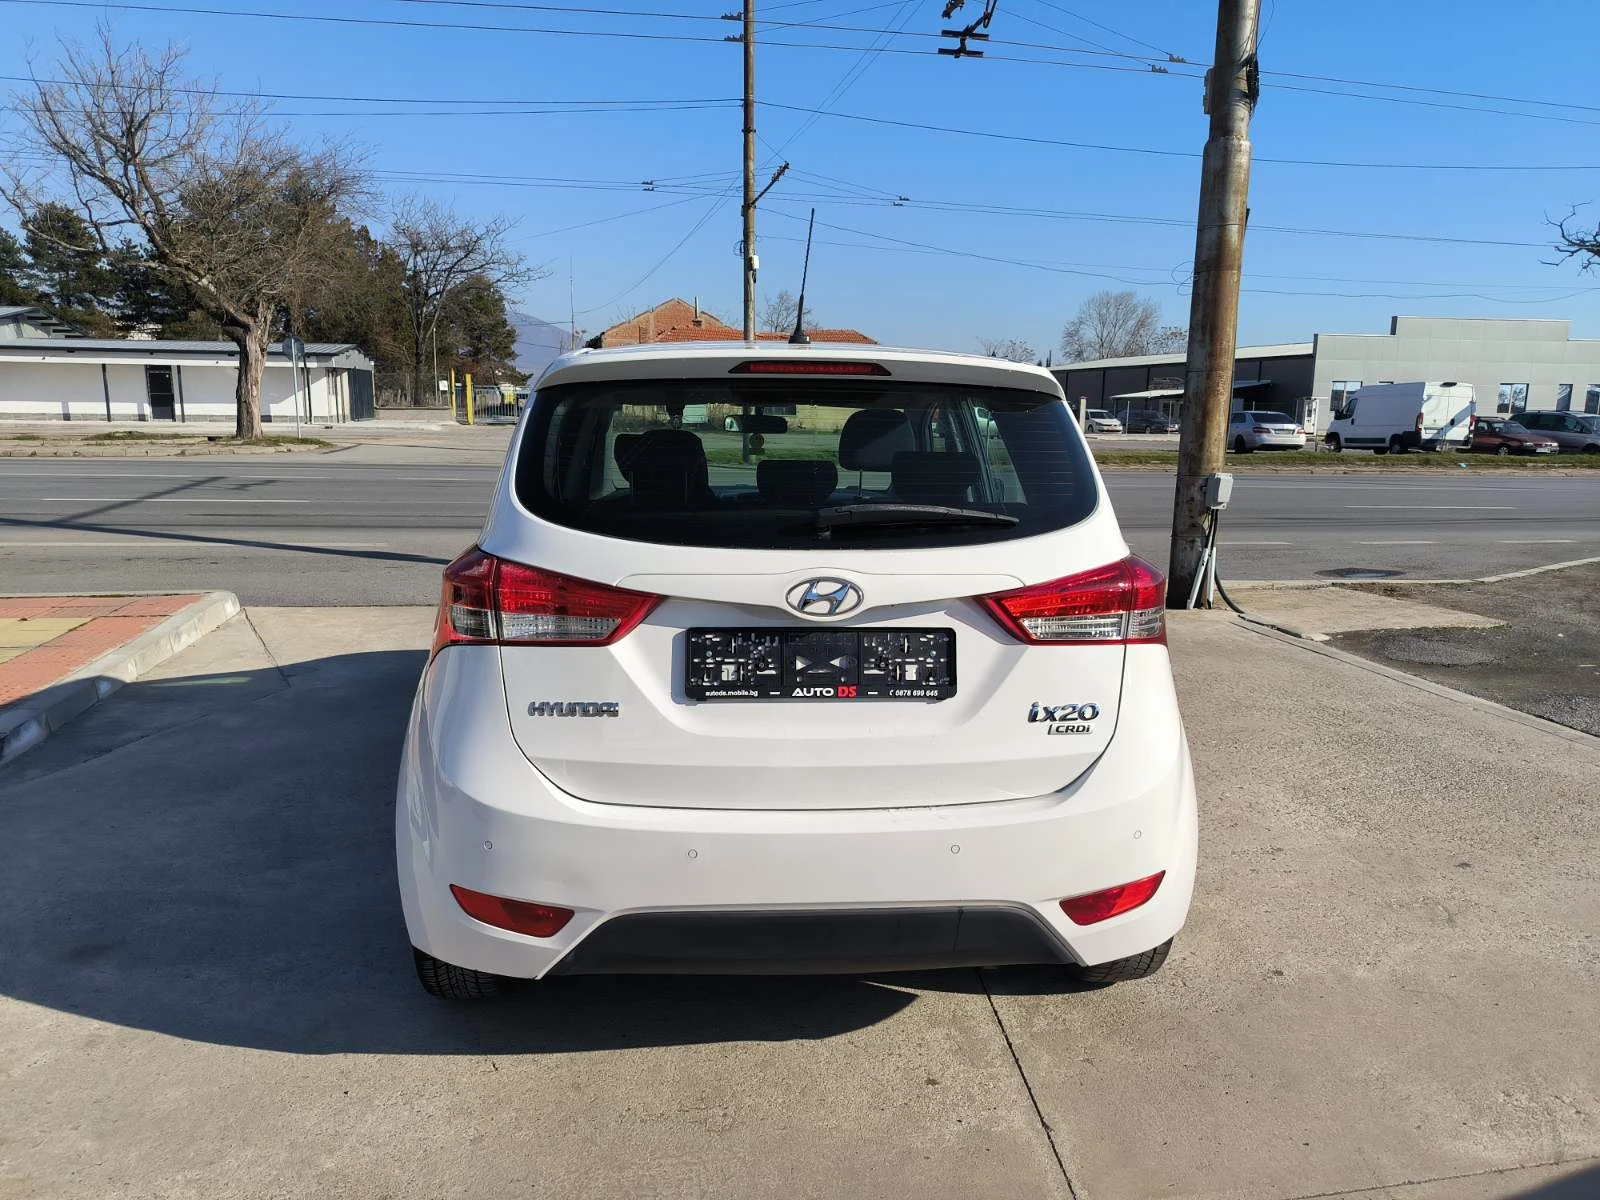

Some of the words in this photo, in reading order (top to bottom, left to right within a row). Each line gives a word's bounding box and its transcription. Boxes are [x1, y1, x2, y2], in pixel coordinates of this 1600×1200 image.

[792, 687, 835, 697] AUTO
[838, 686, 857, 697] DS
[527, 701, 619, 717] HYUNDAI
[1028, 701, 1100, 723] ix20
[1055, 724, 1091, 733] CRDi
